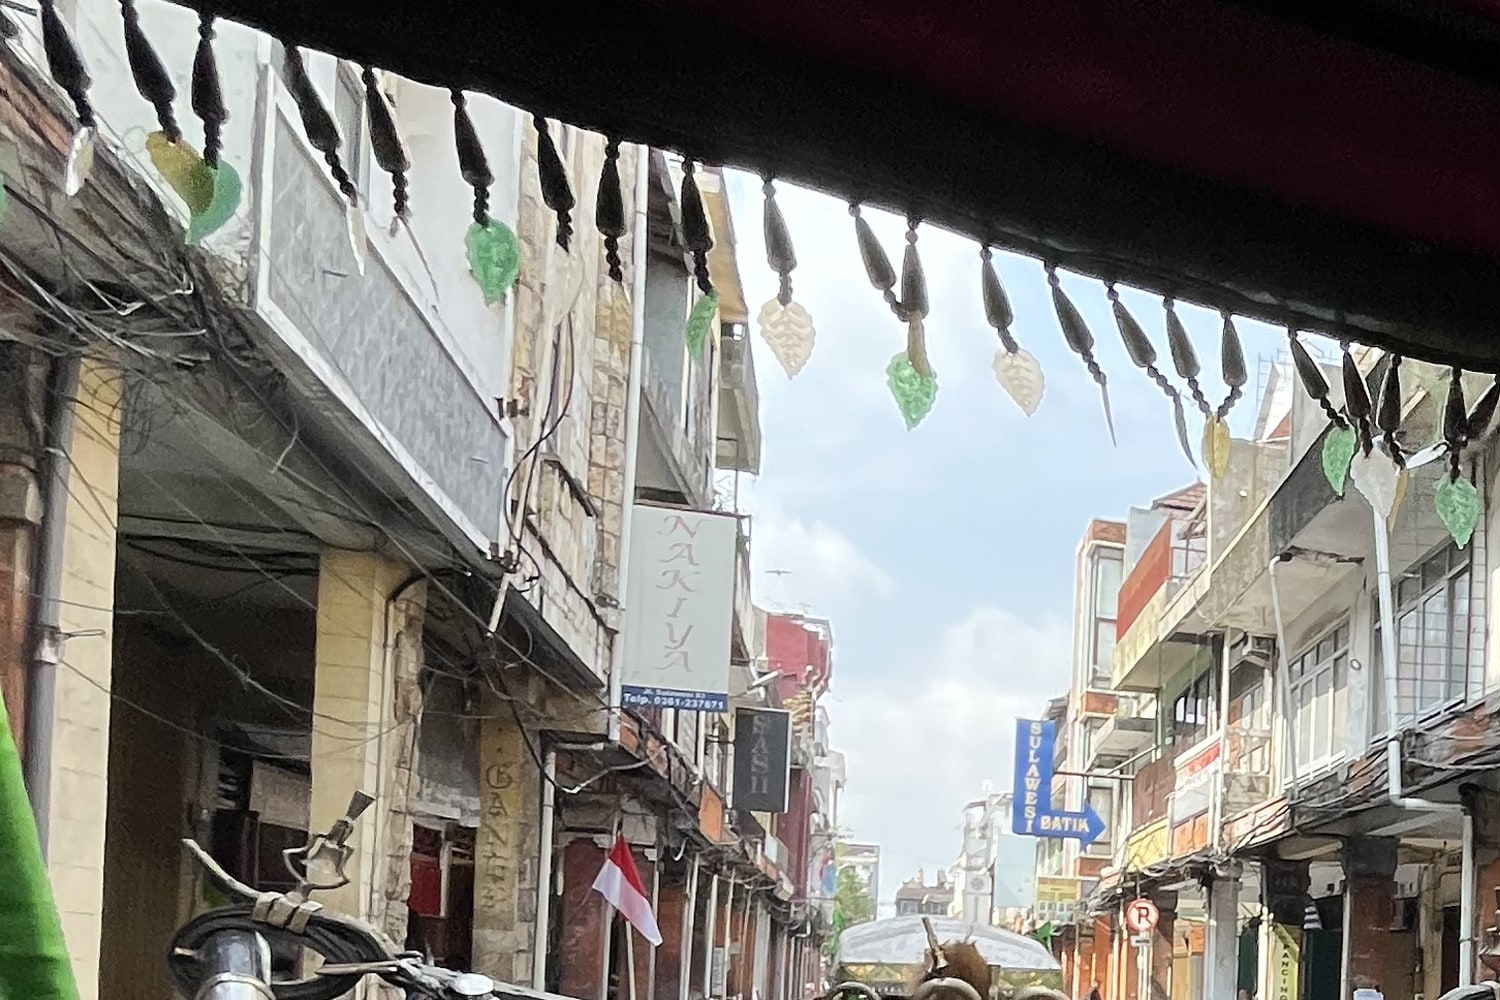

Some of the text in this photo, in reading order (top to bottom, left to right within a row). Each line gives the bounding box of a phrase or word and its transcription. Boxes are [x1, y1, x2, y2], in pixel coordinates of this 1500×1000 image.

[653, 515, 710, 672] NAKIYA
[1024, 722, 1042, 833] SULAWESI
[1040, 815, 1090, 833] BATIK
